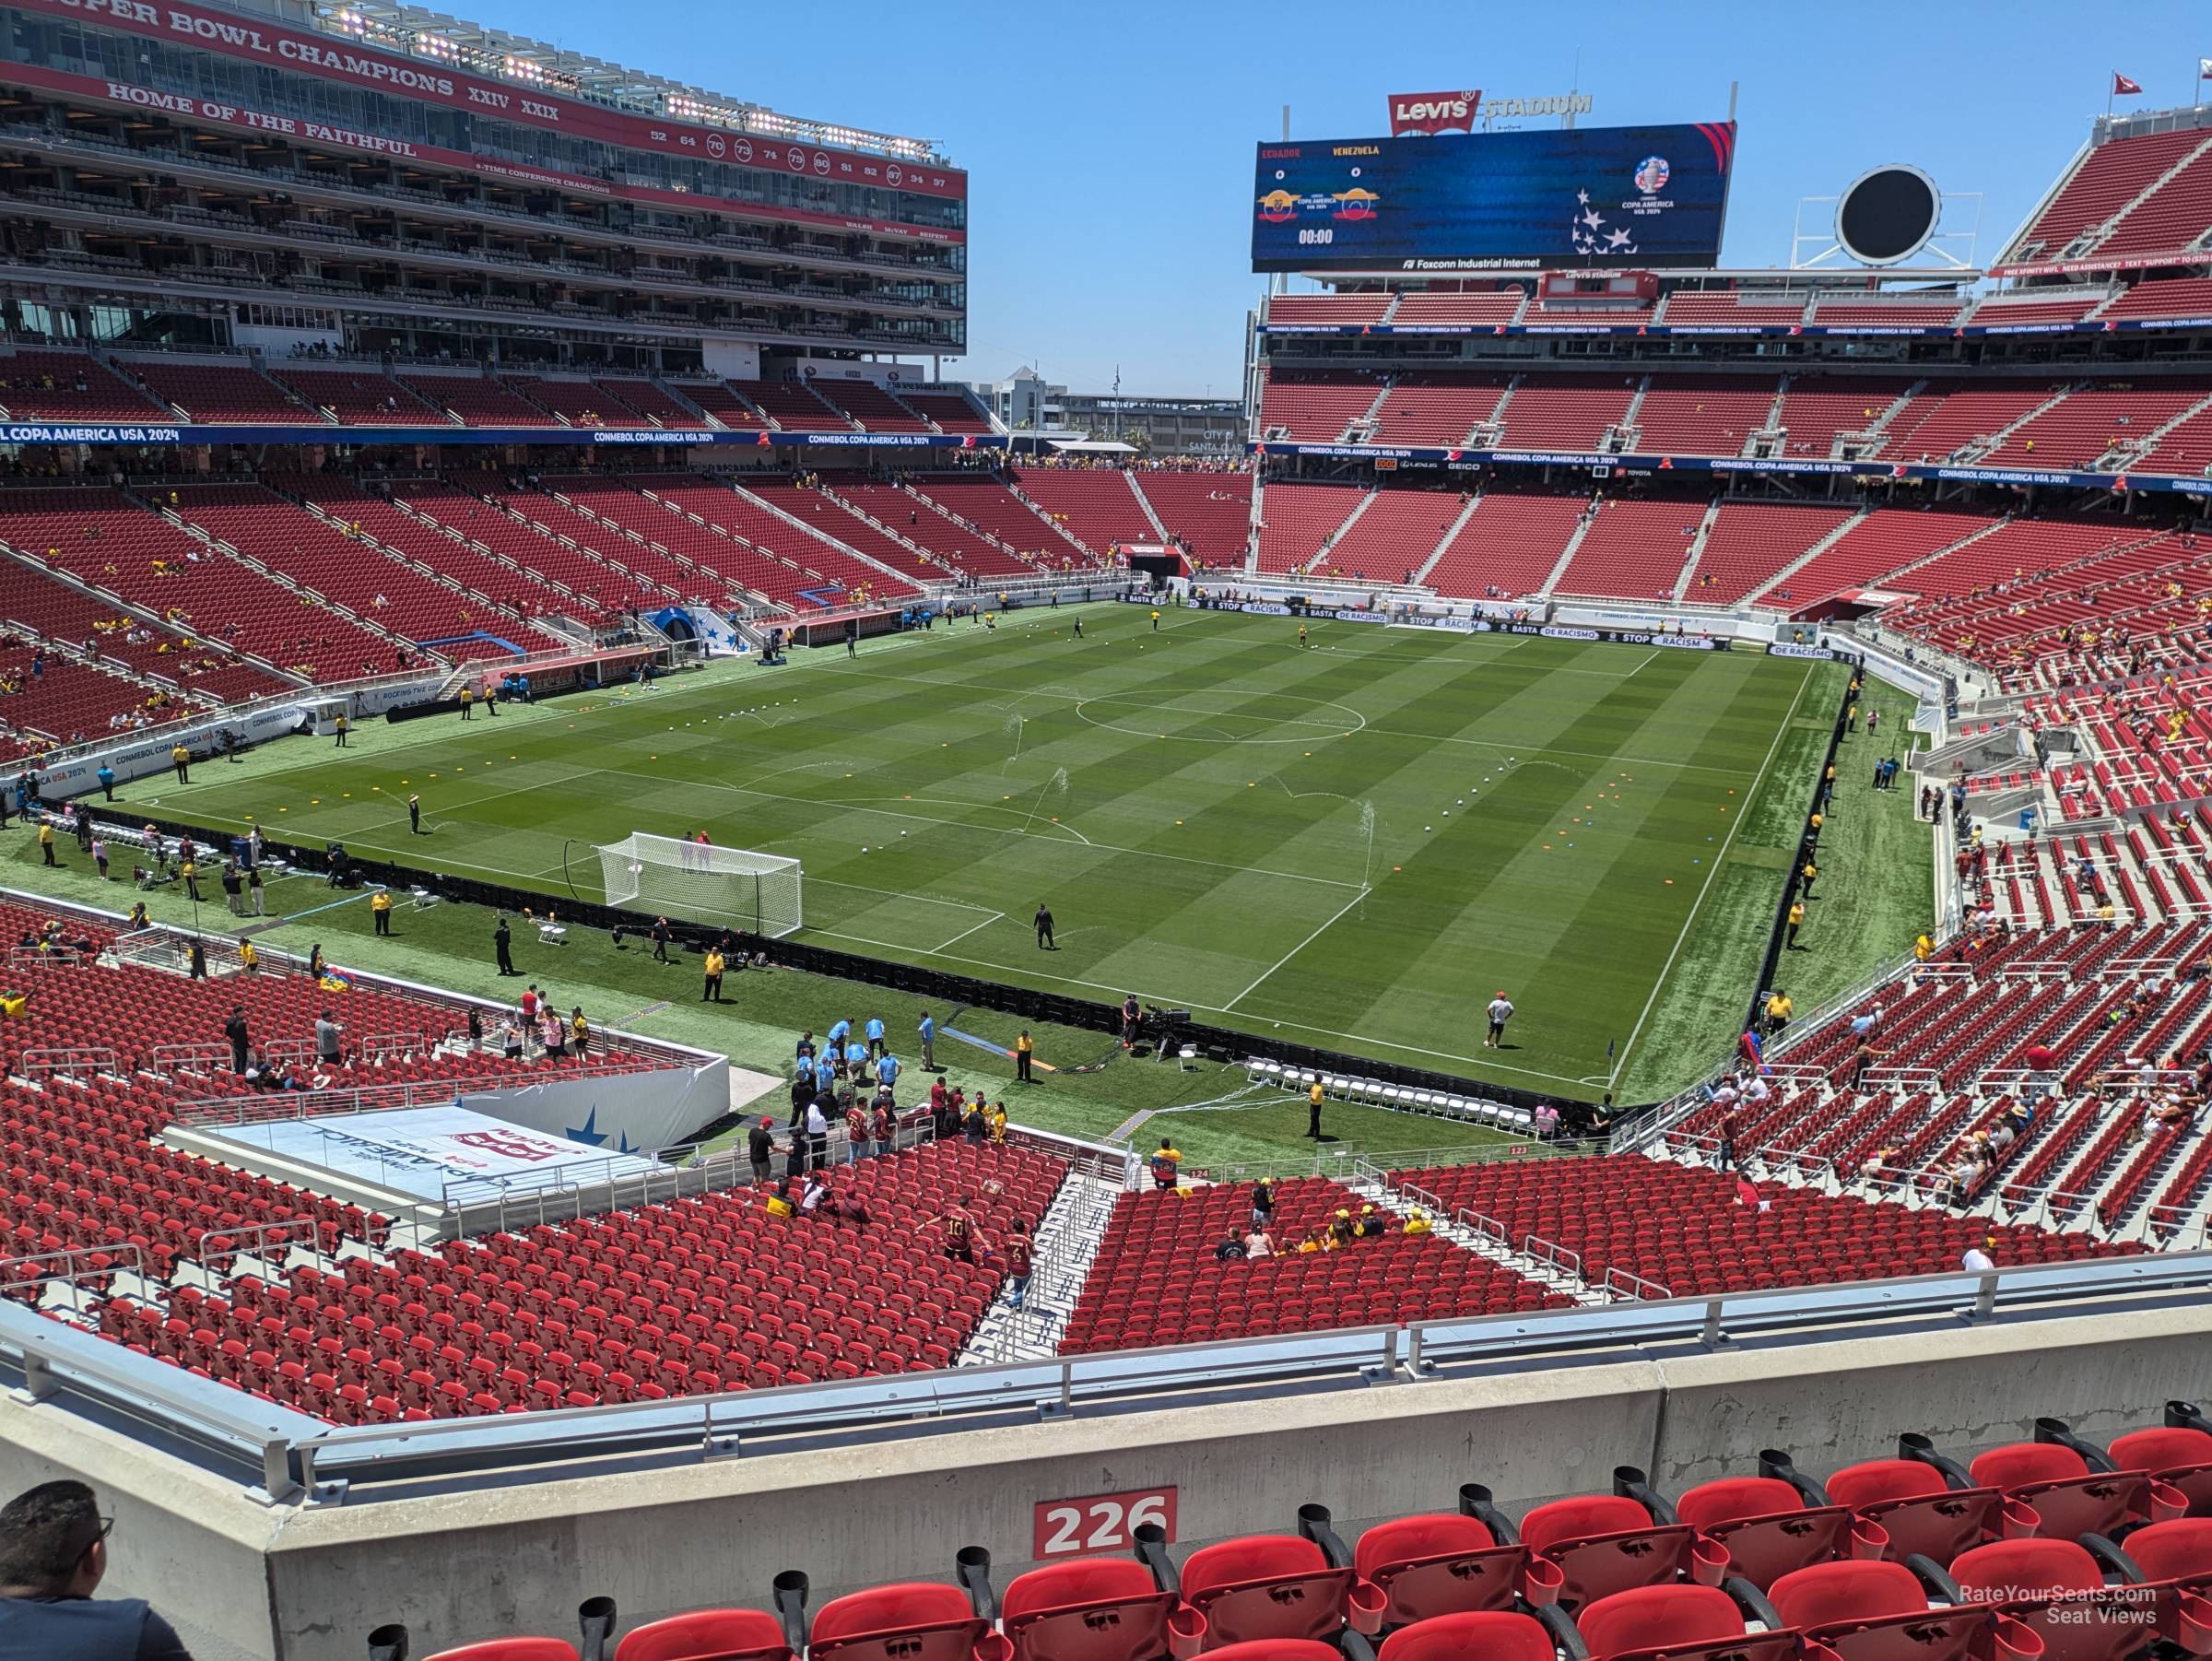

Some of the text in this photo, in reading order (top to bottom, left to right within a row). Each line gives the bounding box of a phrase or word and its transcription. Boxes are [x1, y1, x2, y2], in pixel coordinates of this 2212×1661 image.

[48, 0, 454, 96] PER BOWL CHAMPIONS
[467, 86, 559, 121] XXIV XXIX
[1485, 95, 1593, 118] STADIUM
[107, 83, 417, 157] HOME OF THE FAITHFUL
[650, 131, 666, 141] 52
[679, 136, 696, 147] 64
[709, 140, 724, 151] 70
[736, 145, 751, 155] 73
[763, 150, 777, 160] 74
[1263, 148, 1300, 159] ECUADOR
[1333, 146, 1380, 157] VENEZUELA
[790, 154, 804, 164] 79
[815, 158, 829, 168] 80
[841, 163, 853, 172] 81
[864, 167, 877, 176] 82
[509, 169, 562, 184] CONFERENCE
[563, 180, 611, 194] CHAMPIONS
[1641, 200, 1674, 208] AMERICA
[846, 221, 873, 230] WALSH
[1299, 229, 1333, 244] 00:00
[1417, 258, 1540, 270] Foxconn Industrial Internet
[2062, 265, 2078, 273] NEED
[10, 428, 53, 442] COPA
[52, 428, 118, 442] AMERICA
[120, 429, 147, 442] USA
[148, 429, 180, 442] 2024
[594, 432, 713, 442] CONMEBOL COPA AMERICA USA 2024
[808, 435, 929, 444] CONMEBOL COPA AMERICA USA 2024
[1203, 430, 1223, 440] CITY
[1189, 442, 1217, 452] SANTA
[1334, 447, 1353, 455] COPA
[1352, 448, 1382, 456] AMERICA
[1531, 454, 1551, 463] COPA
[1550, 455, 1584, 464] AMERICA
[1448, 463, 1480, 471] GEICO
[1710, 460, 1754, 469] CONMEBOL
[1754, 462, 1777, 470] COPA
[1776, 462, 1813, 471] AMERICA
[1814, 464, 1830, 472] USA
[1938, 469, 2071, 483] CONMEBOL COPA AMERICA USA 2024
[2171, 480, 2197, 490] CONMEBOL
[1129, 595, 1150, 603] BASTA
[1218, 603, 1281, 614] STOP RACISM
[1310, 609, 1334, 618] BASTA
[1350, 613, 1385, 621] RACISMO
[1409, 617, 1479, 629] STOP RACISM
[1512, 625, 1537, 635] BASTA
[1557, 629, 1595, 639] RACISMO
[1622, 633, 1651, 643] STOP
[1662, 637, 1701, 647] RACISM
[1774, 646, 1831, 658] DE RACISMO
[383, 685, 426, 700] ROCKING THE
[252, 713, 284, 728] CONMEBOL
[115, 748, 156, 765] CONMEBOL
[155, 744, 174, 755] COPA
[201, 733, 215, 743] USA
[52, 774, 68, 783] USA
[67, 767, 87, 779] 2024
[490, 1127, 588, 1155] STADIUM
[1015, 1134, 1030, 1143] 125
[1511, 1147, 1527, 1155] 123
[1191, 1170, 1208, 1178] 124
[947, 1219, 963, 1236] 10
[1043, 1496, 1168, 1554] 226
